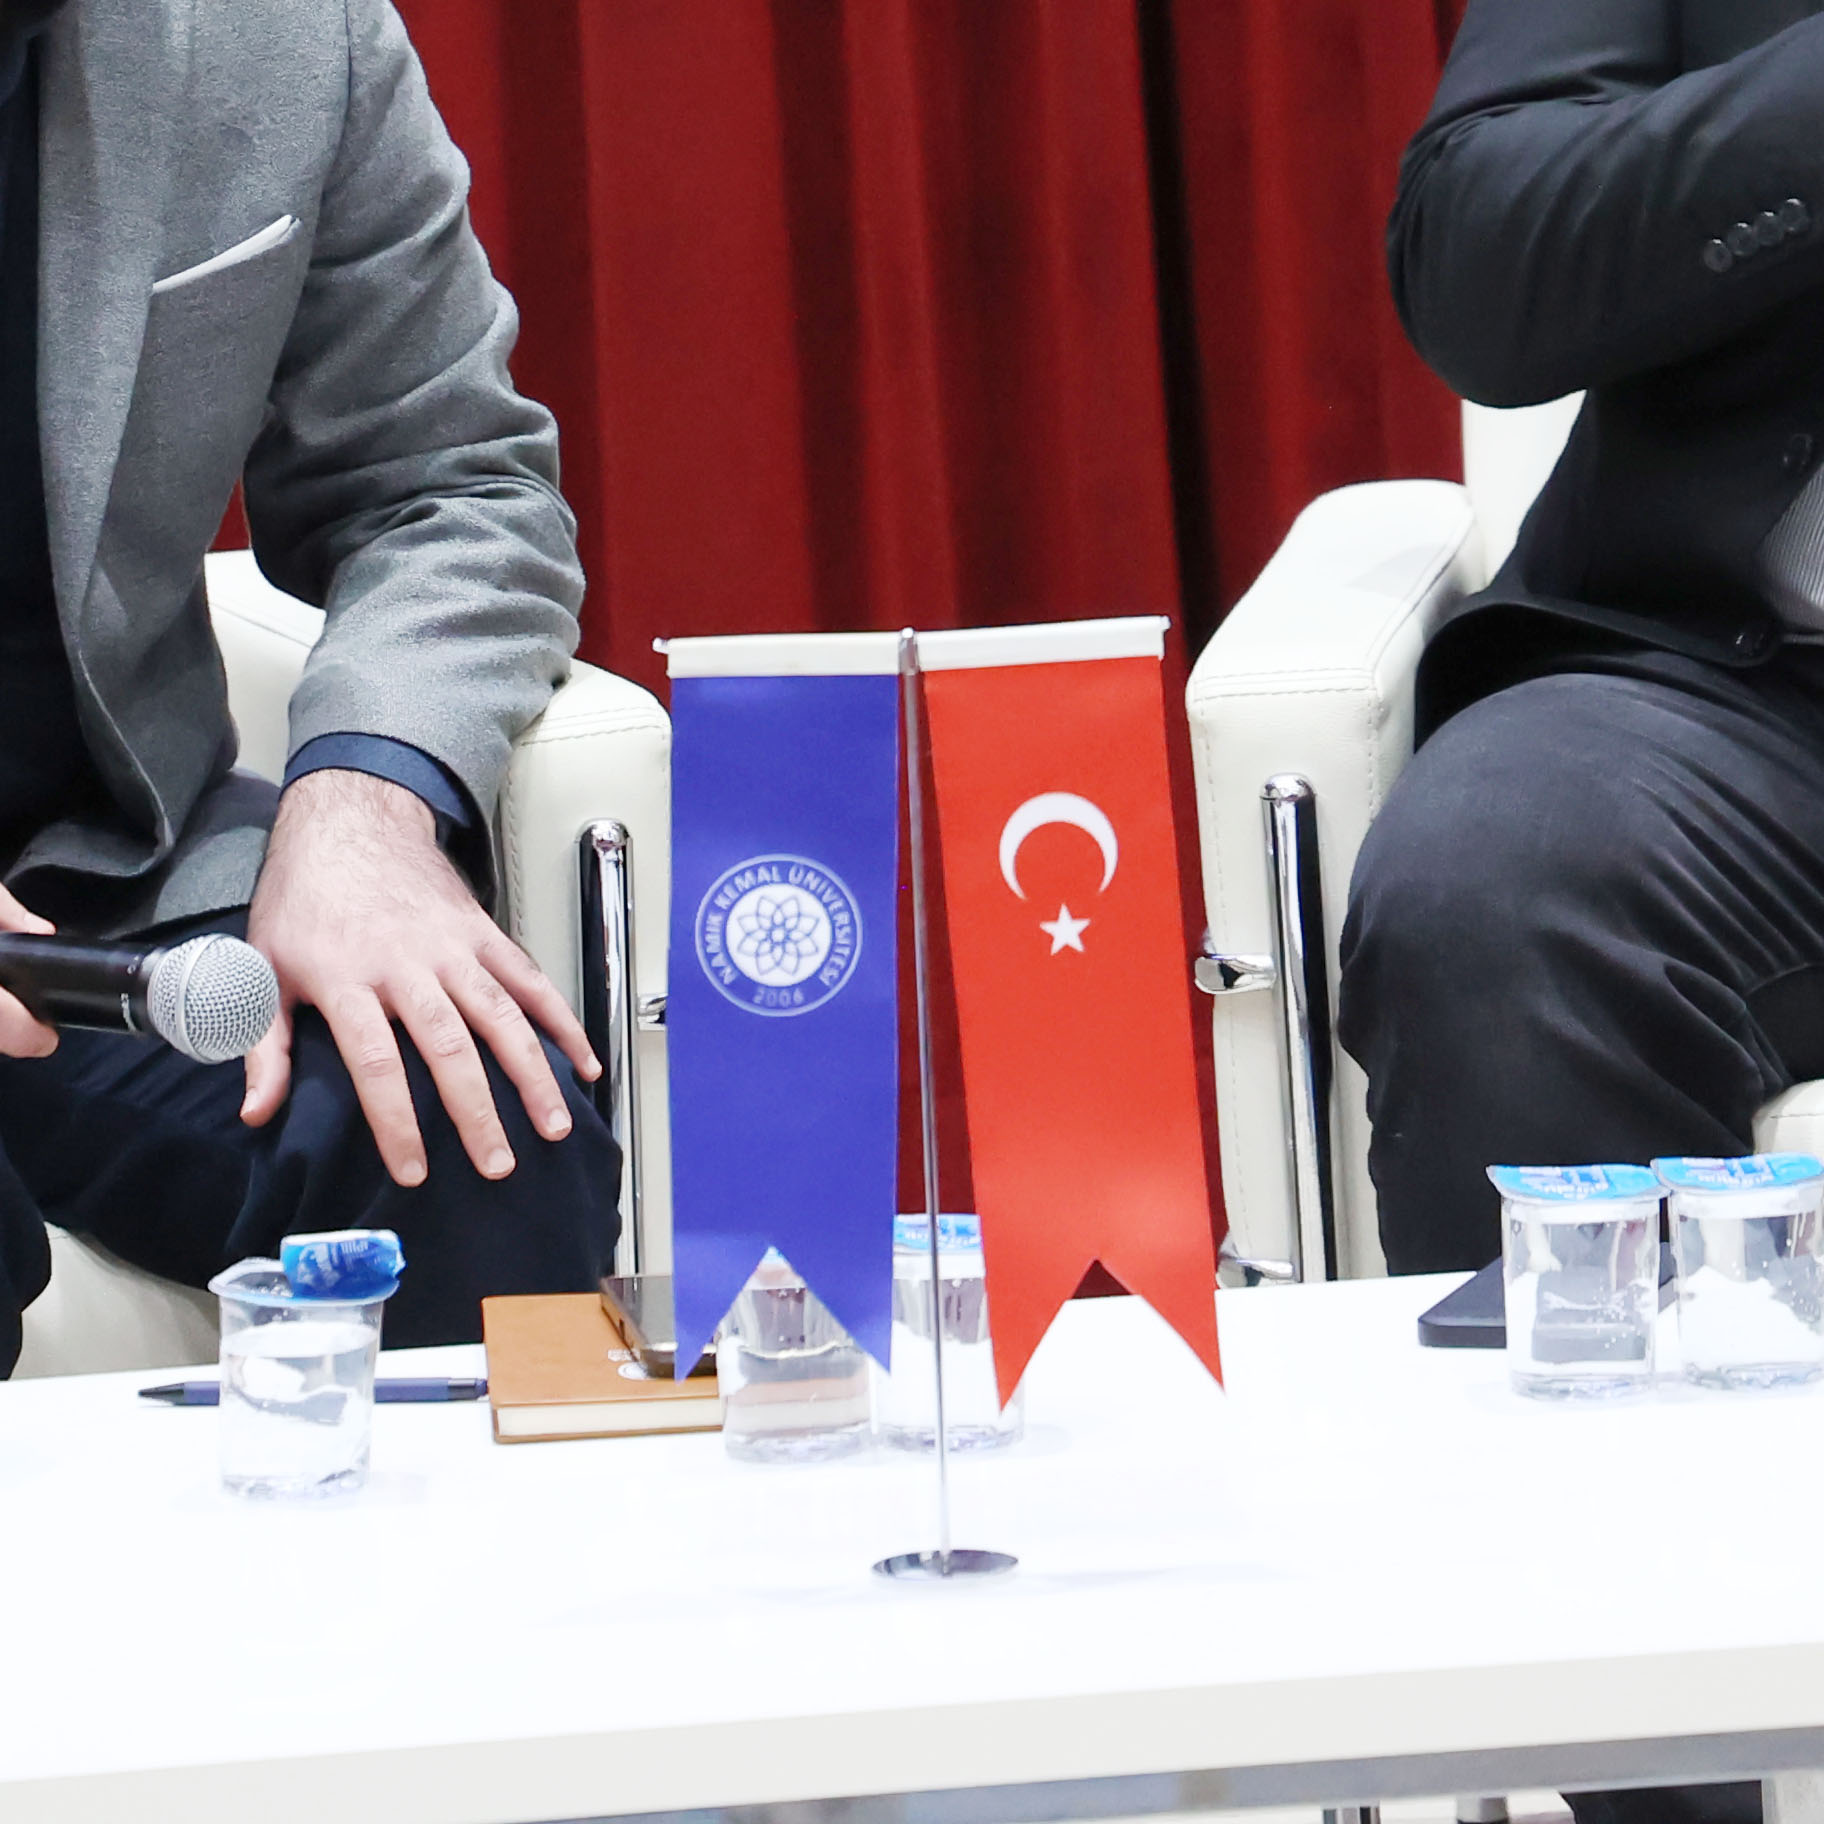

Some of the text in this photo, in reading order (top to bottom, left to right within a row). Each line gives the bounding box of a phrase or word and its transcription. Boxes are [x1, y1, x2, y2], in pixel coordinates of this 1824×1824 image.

[714, 864, 782, 911] KEMAL
[705, 912, 738, 985] NAMIK
[752, 985, 806, 1008] 2006
